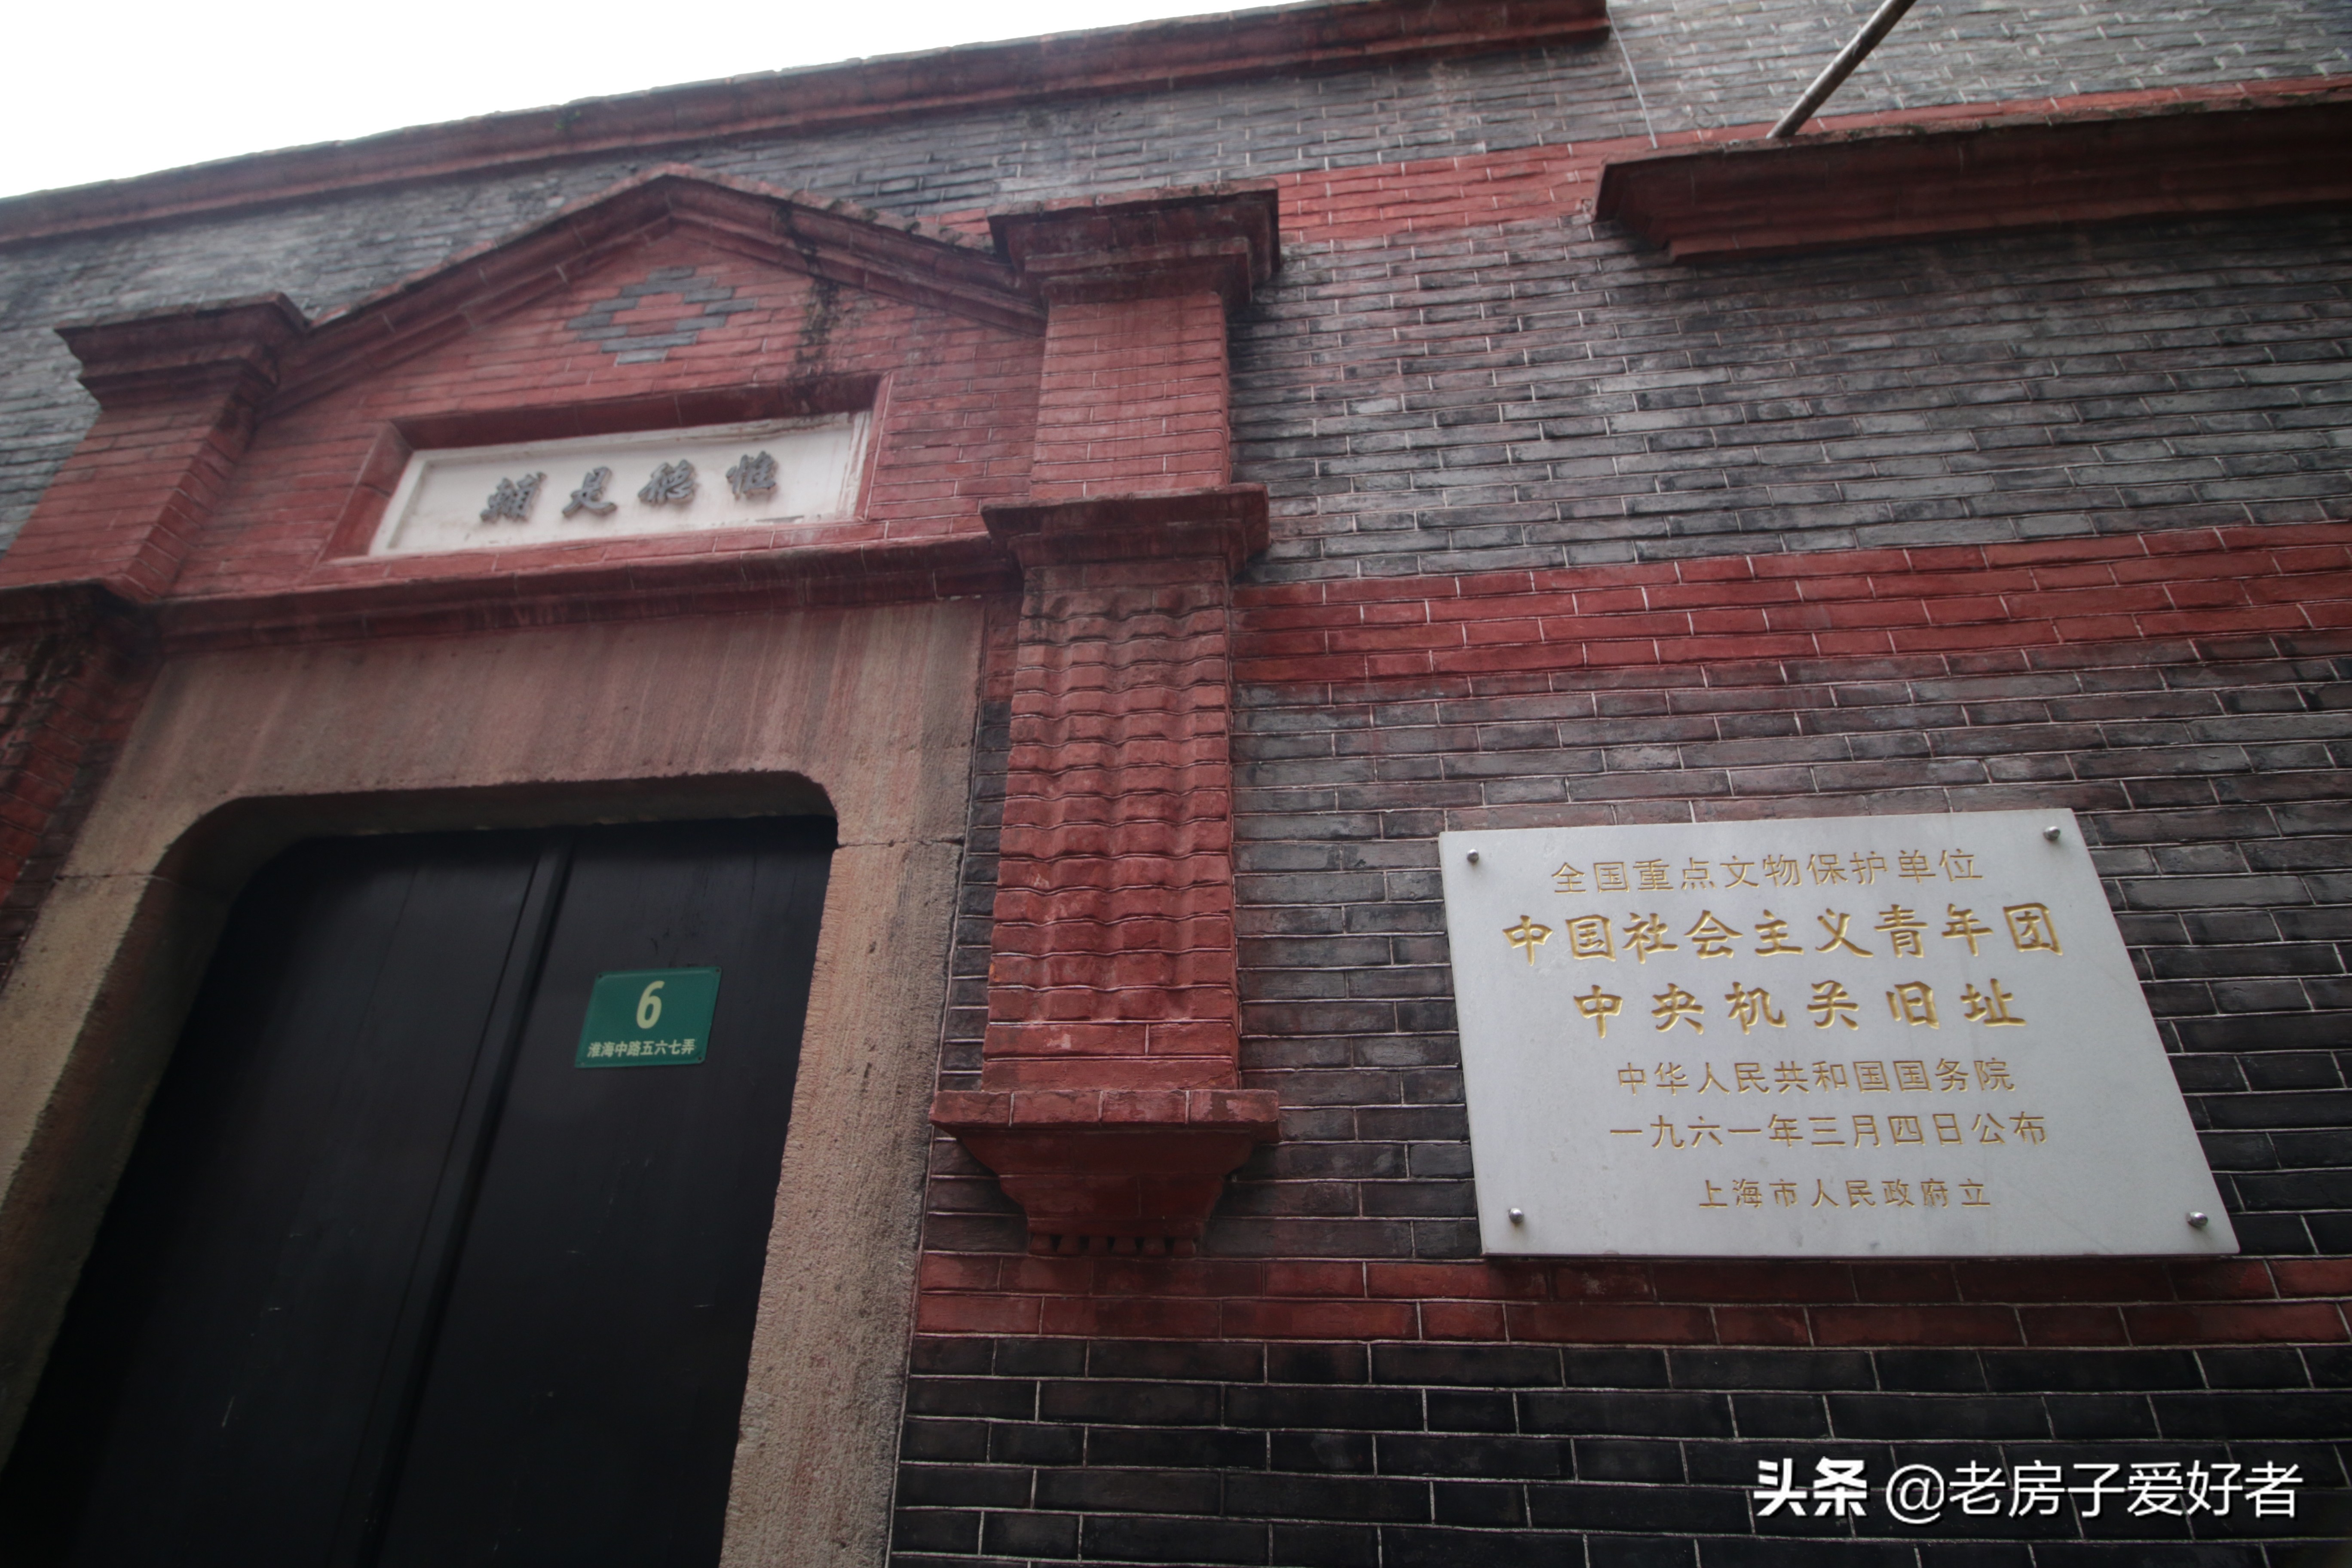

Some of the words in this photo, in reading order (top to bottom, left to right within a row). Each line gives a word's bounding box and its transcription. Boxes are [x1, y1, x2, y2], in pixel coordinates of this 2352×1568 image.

[1551, 849, 1984, 894] 全国重点文物保护单位
[1503, 903, 2064, 966] 中国社会主义青年团
[636, 980, 665, 1029] 6
[1574, 979, 2027, 1039] 中央机关旧址
[587, 1038, 695, 1058] 淮海中路五六七弄
[1619, 1059, 2016, 1096] 中华人民共和国国务院
[1611, 1112, 2048, 1149] 一九六一年三月四日公布
[1700, 1179, 1991, 1209] 上海市人民政府立
